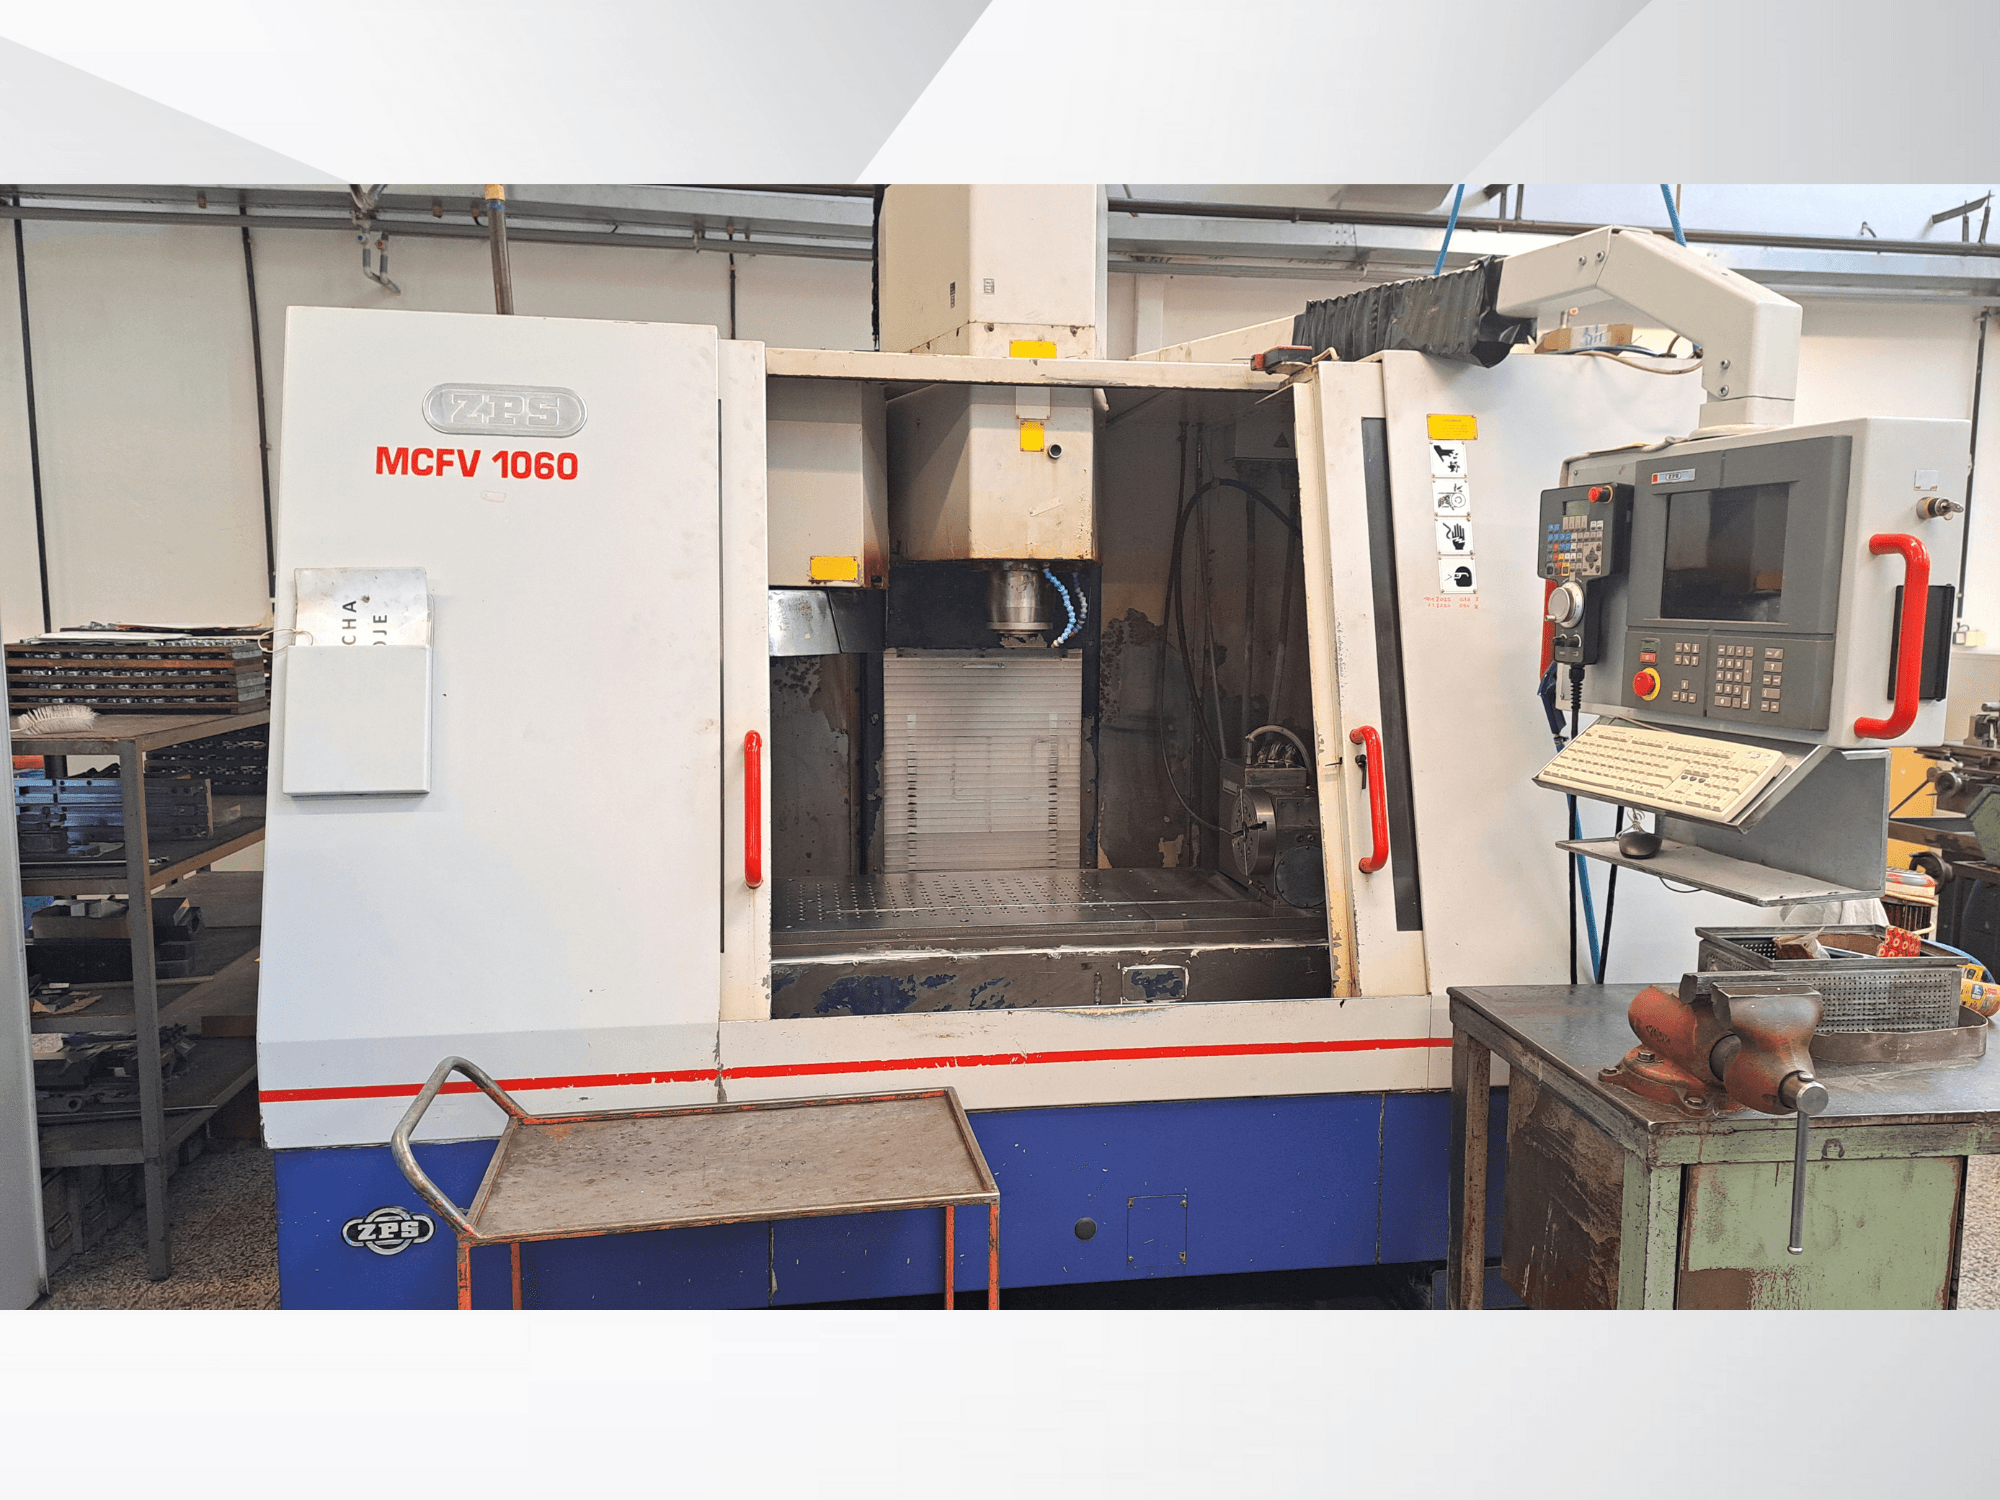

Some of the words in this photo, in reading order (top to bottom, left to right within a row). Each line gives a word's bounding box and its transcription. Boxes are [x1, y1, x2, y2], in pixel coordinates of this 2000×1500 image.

[451, 394, 560, 426] ZPS
[376, 446, 481, 478] MCFV
[491, 450, 578, 480] 1060
[341, 600, 357, 646] CHA
[357, 1221, 419, 1241] ZPS
